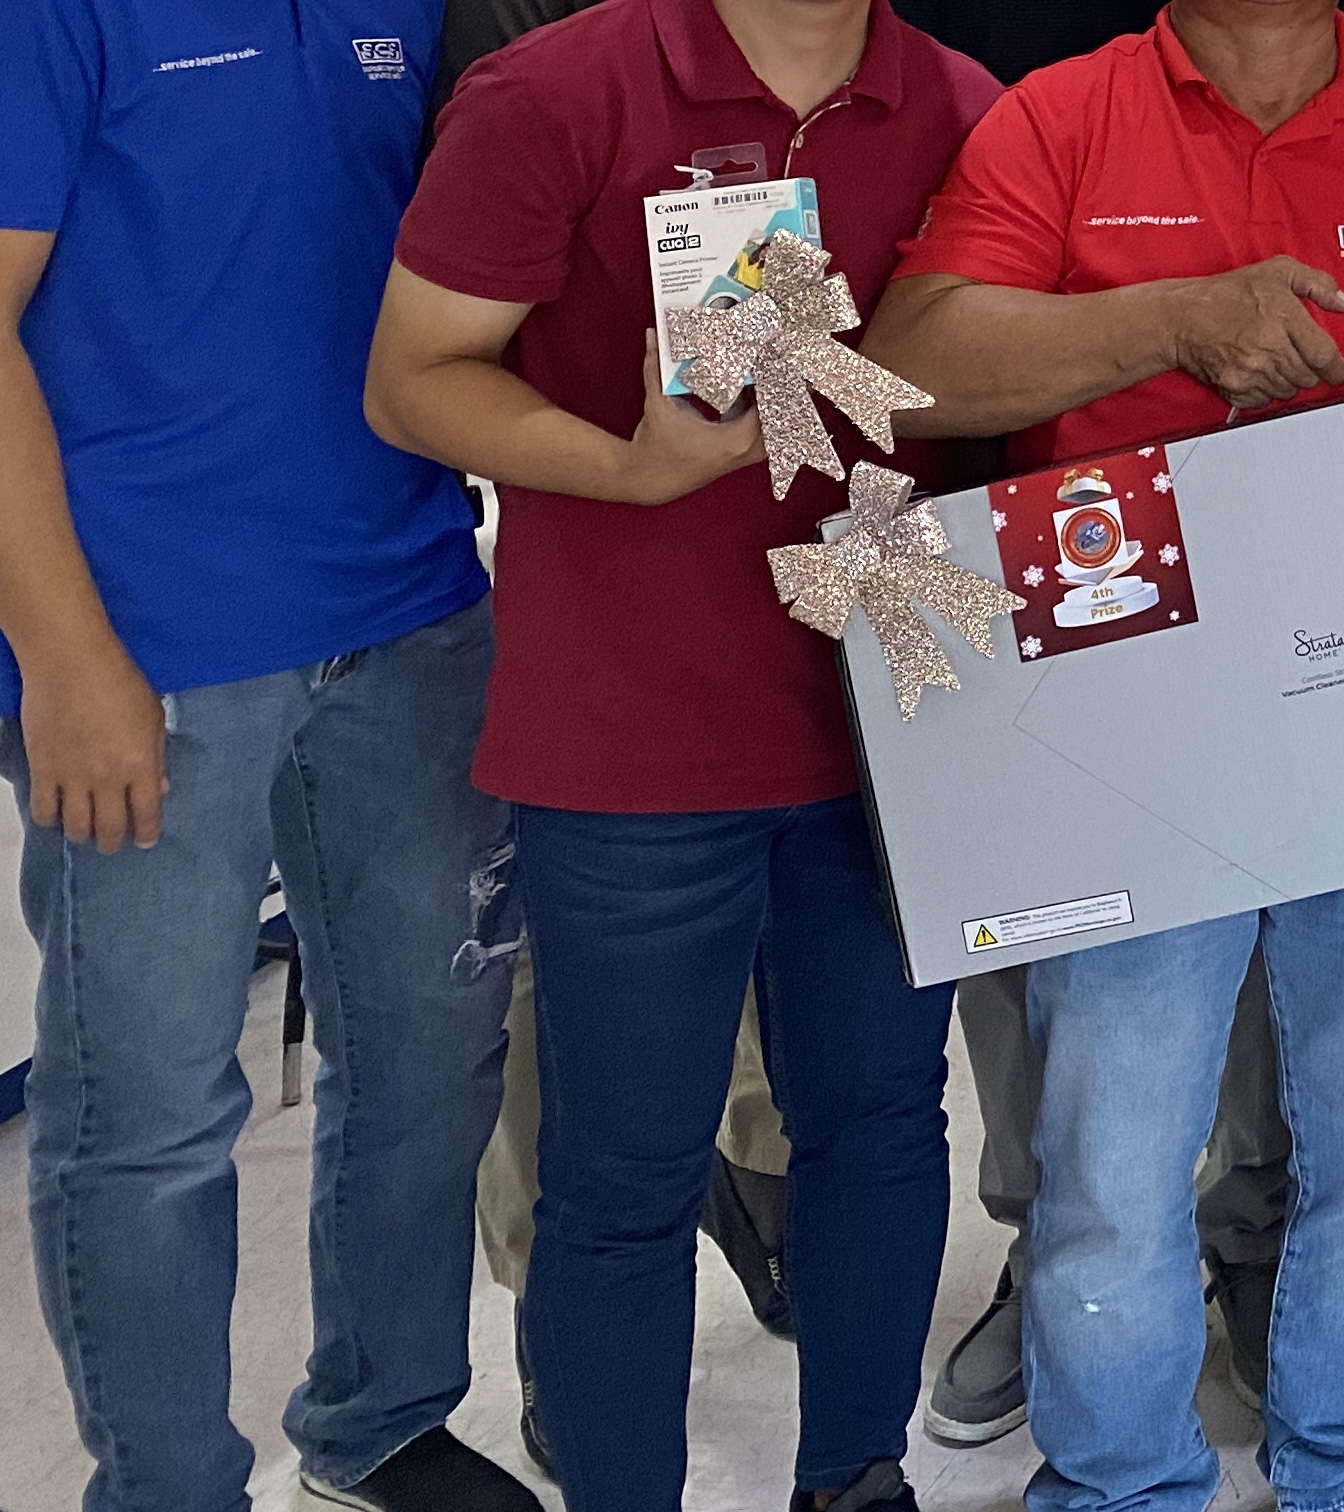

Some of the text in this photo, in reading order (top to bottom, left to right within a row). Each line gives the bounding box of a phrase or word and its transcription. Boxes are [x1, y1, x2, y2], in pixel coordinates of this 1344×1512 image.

[654, 202, 699, 215] Canon
[1090, 587, 1114, 600] 4th
[1090, 603, 1124, 619] Prize
